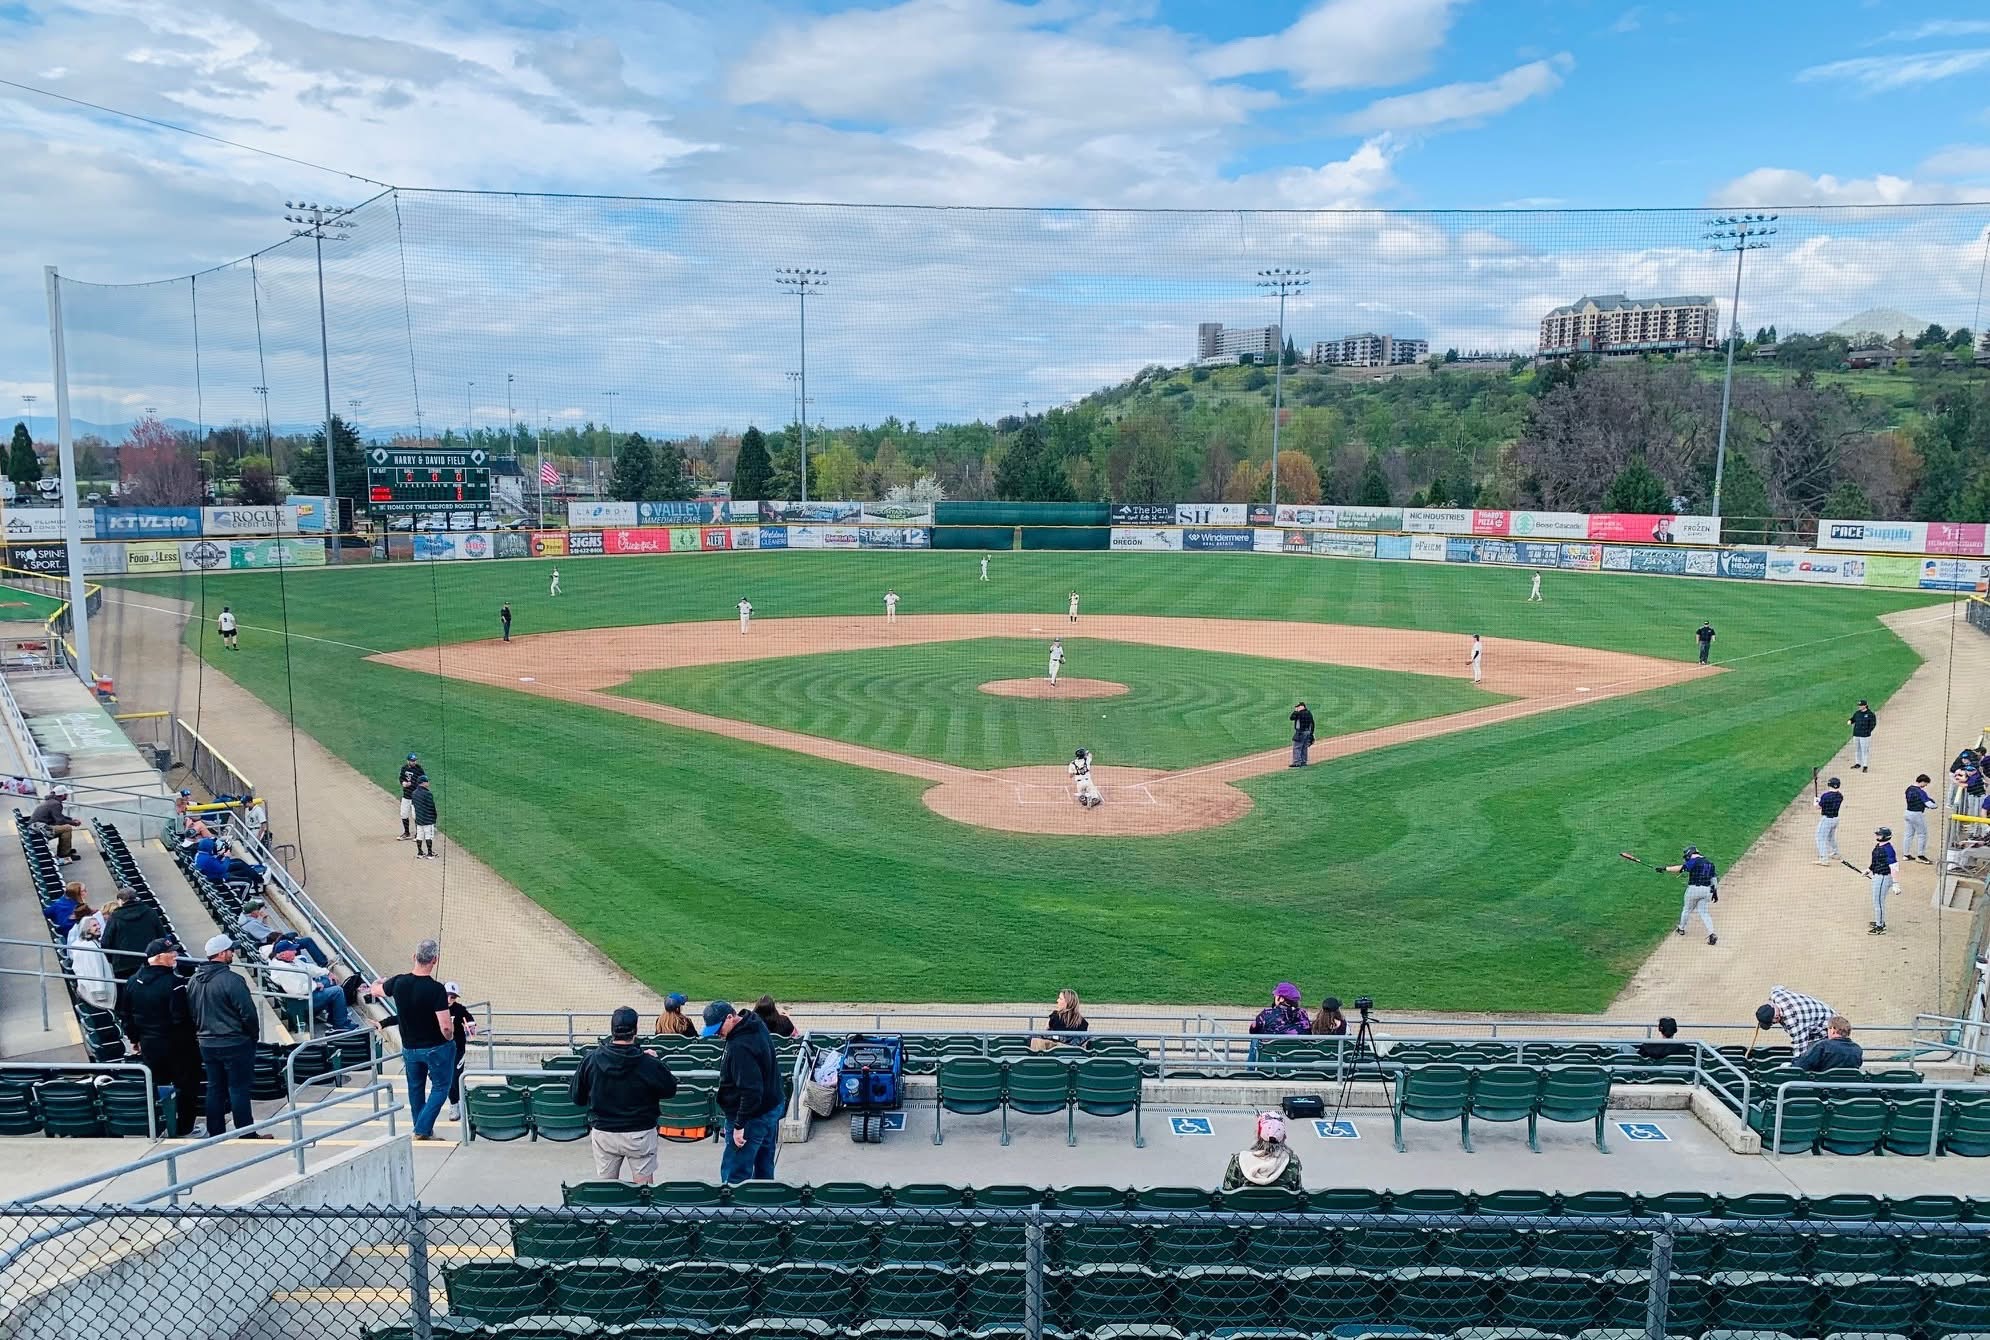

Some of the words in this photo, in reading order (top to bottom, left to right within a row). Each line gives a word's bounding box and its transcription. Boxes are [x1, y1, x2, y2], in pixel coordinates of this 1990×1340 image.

[394, 456, 416, 464] HARRY
[418, 456, 423, 464] &
[425, 456, 445, 465] DAVID
[447, 456, 466, 465] FIELD
[432, 473, 438, 482] 0
[456, 473, 462, 482] 0
[652, 503, 702, 516] VALLEY
[1132, 506, 1150, 514] The
[1151, 506, 1169, 514] Den
[233, 510, 286, 523] ROGUE
[641, 516, 681, 524] IMMEDIATE
[682, 516, 702, 524] CARE
[1409, 512, 1421, 520] NIC
[1422, 513, 1465, 521] INDUSTRIES
[110, 516, 163, 529] KTVL
[859, 528, 901, 537] STORM
[902, 529, 925, 544] 12
[1201, 533, 1250, 542] Windermere
[1832, 526, 1863, 538] PACE
[1864, 527, 1912, 541] Supply
[569, 537, 603, 547] SIGNS
[706, 535, 726, 547] ALERT
[38, 549, 65, 558] SPINE
[1482, 552, 1498, 561] NEW
[1632, 550, 1687, 558] WELCOME
[30, 560, 60, 569] SPORT
